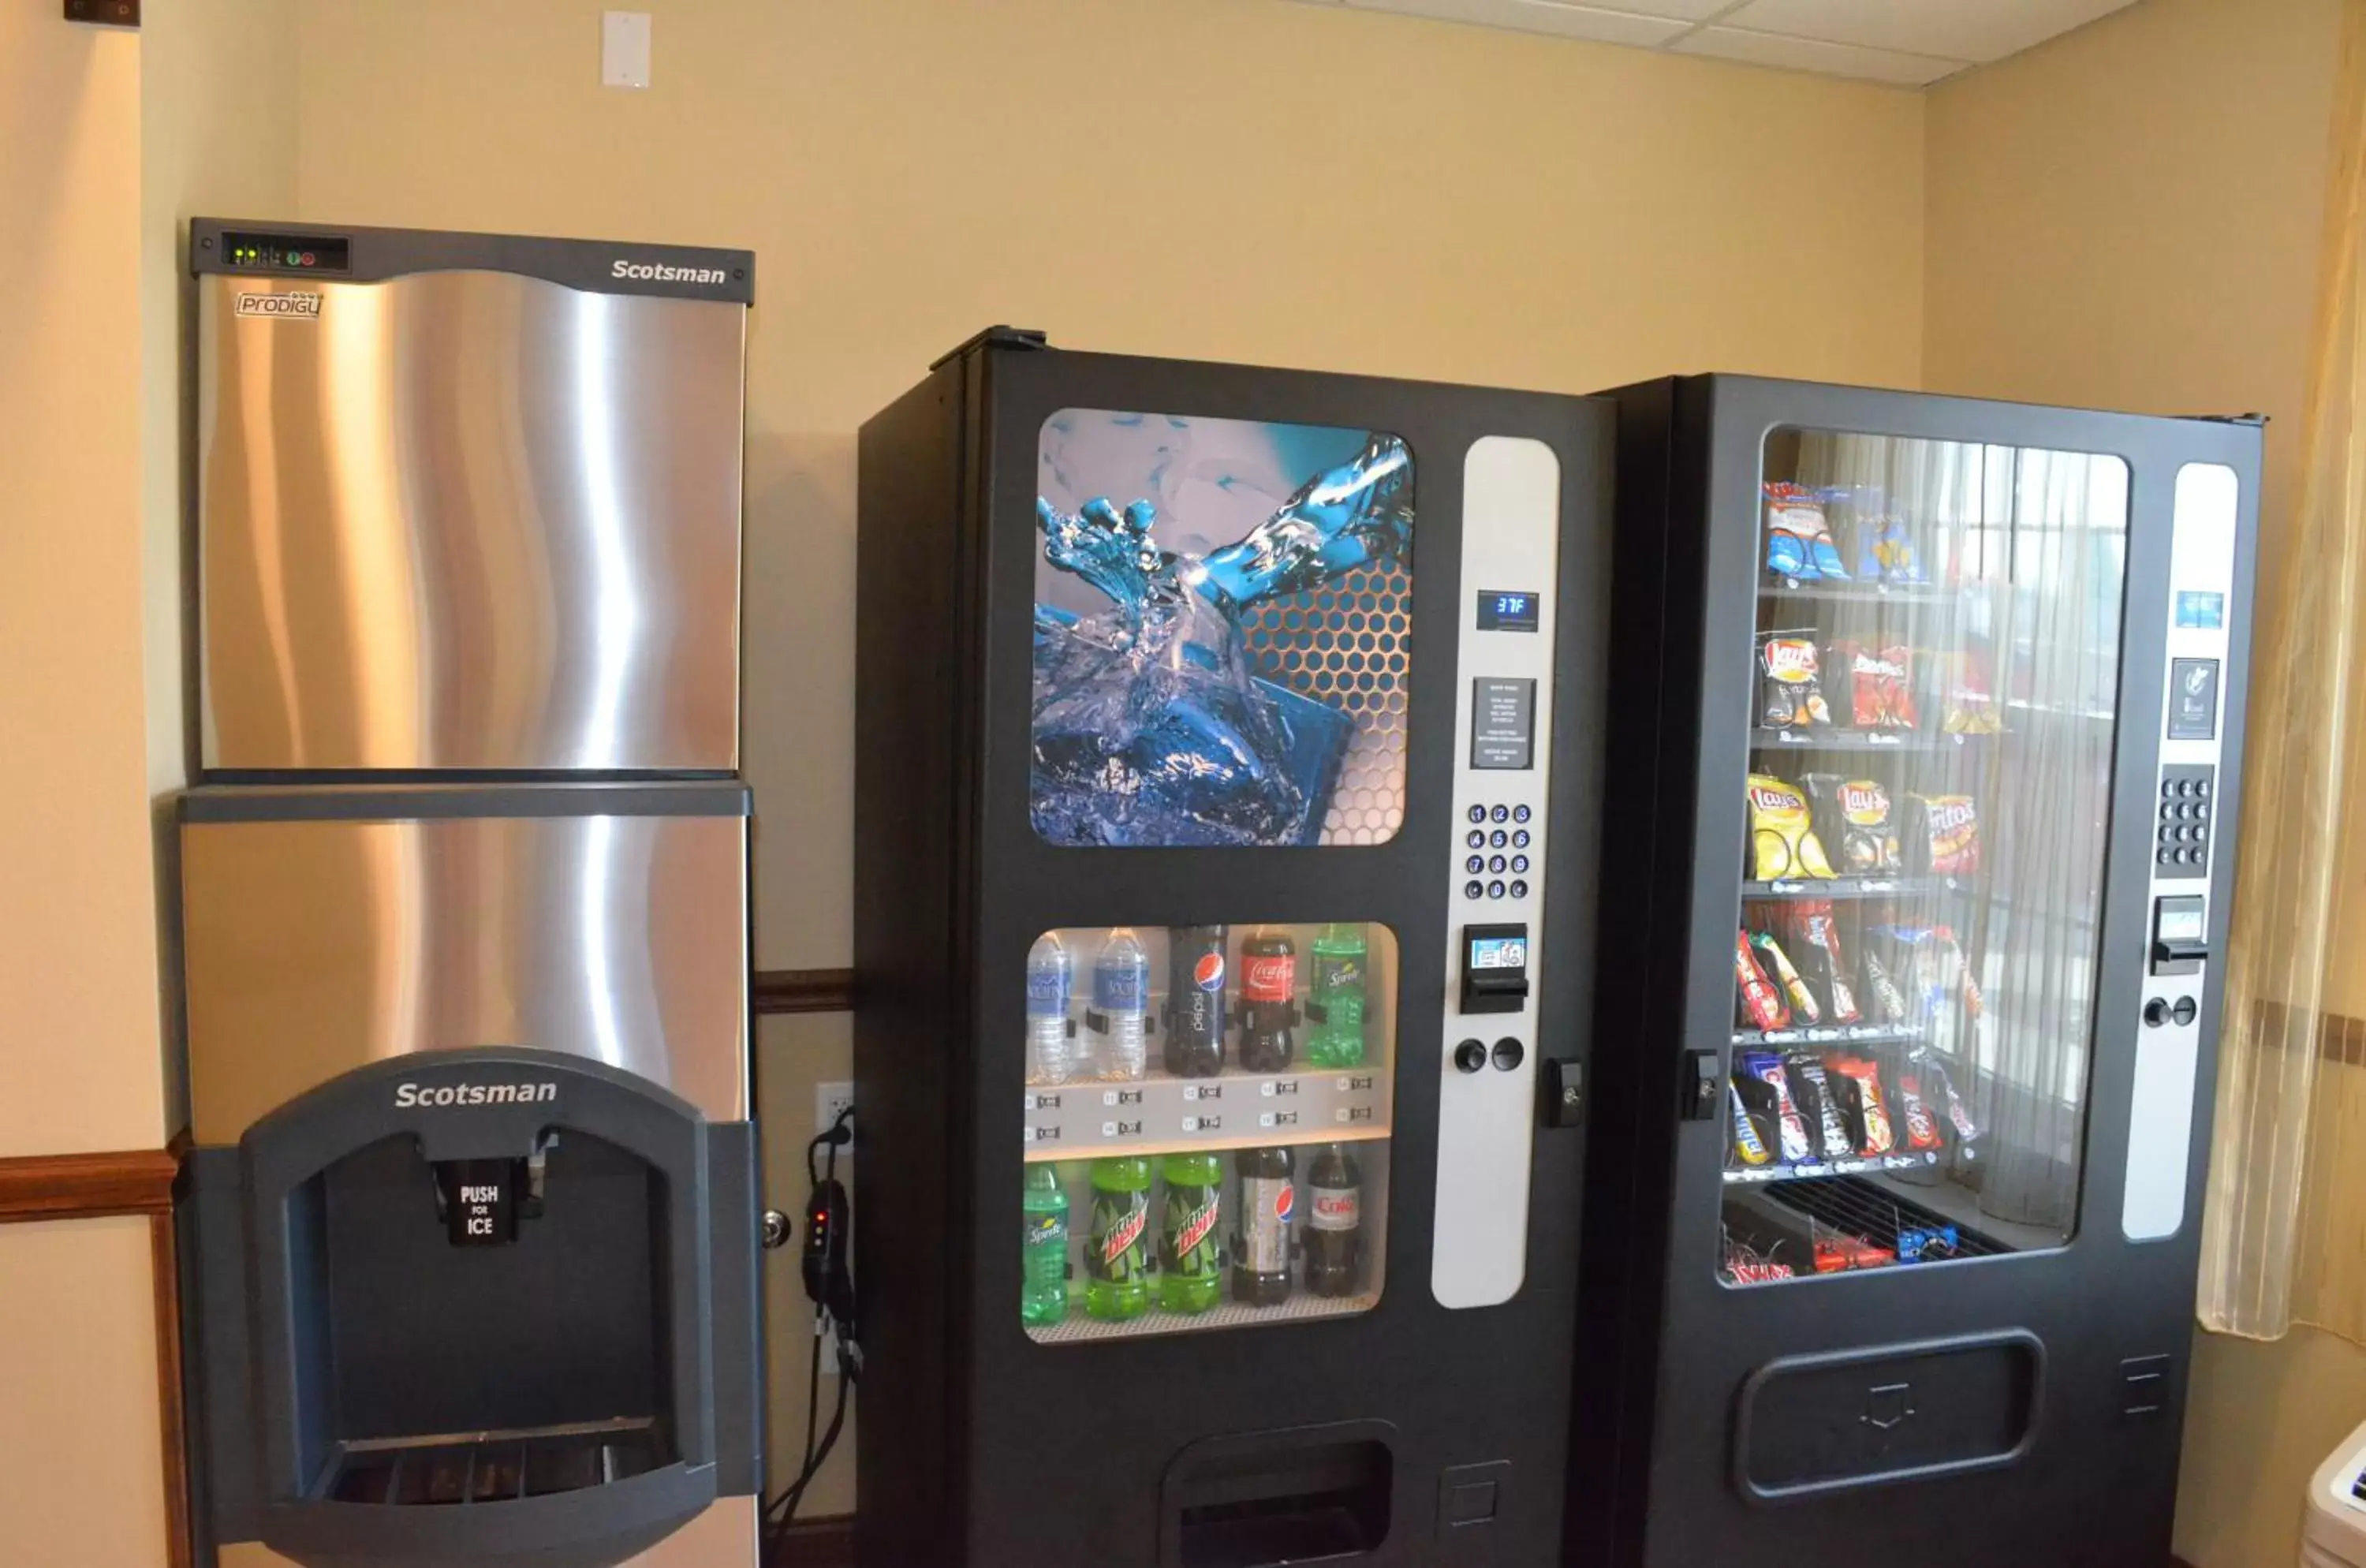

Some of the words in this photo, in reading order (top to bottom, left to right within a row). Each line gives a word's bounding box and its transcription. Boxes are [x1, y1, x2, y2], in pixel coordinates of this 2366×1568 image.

[610, 259, 726, 285] Scotsman
[1192, 991, 1206, 1032] pepsi
[394, 1081, 558, 1107] Scotsman
[461, 1185, 498, 1204] PUSH
[468, 1218, 493, 1235] ICE
